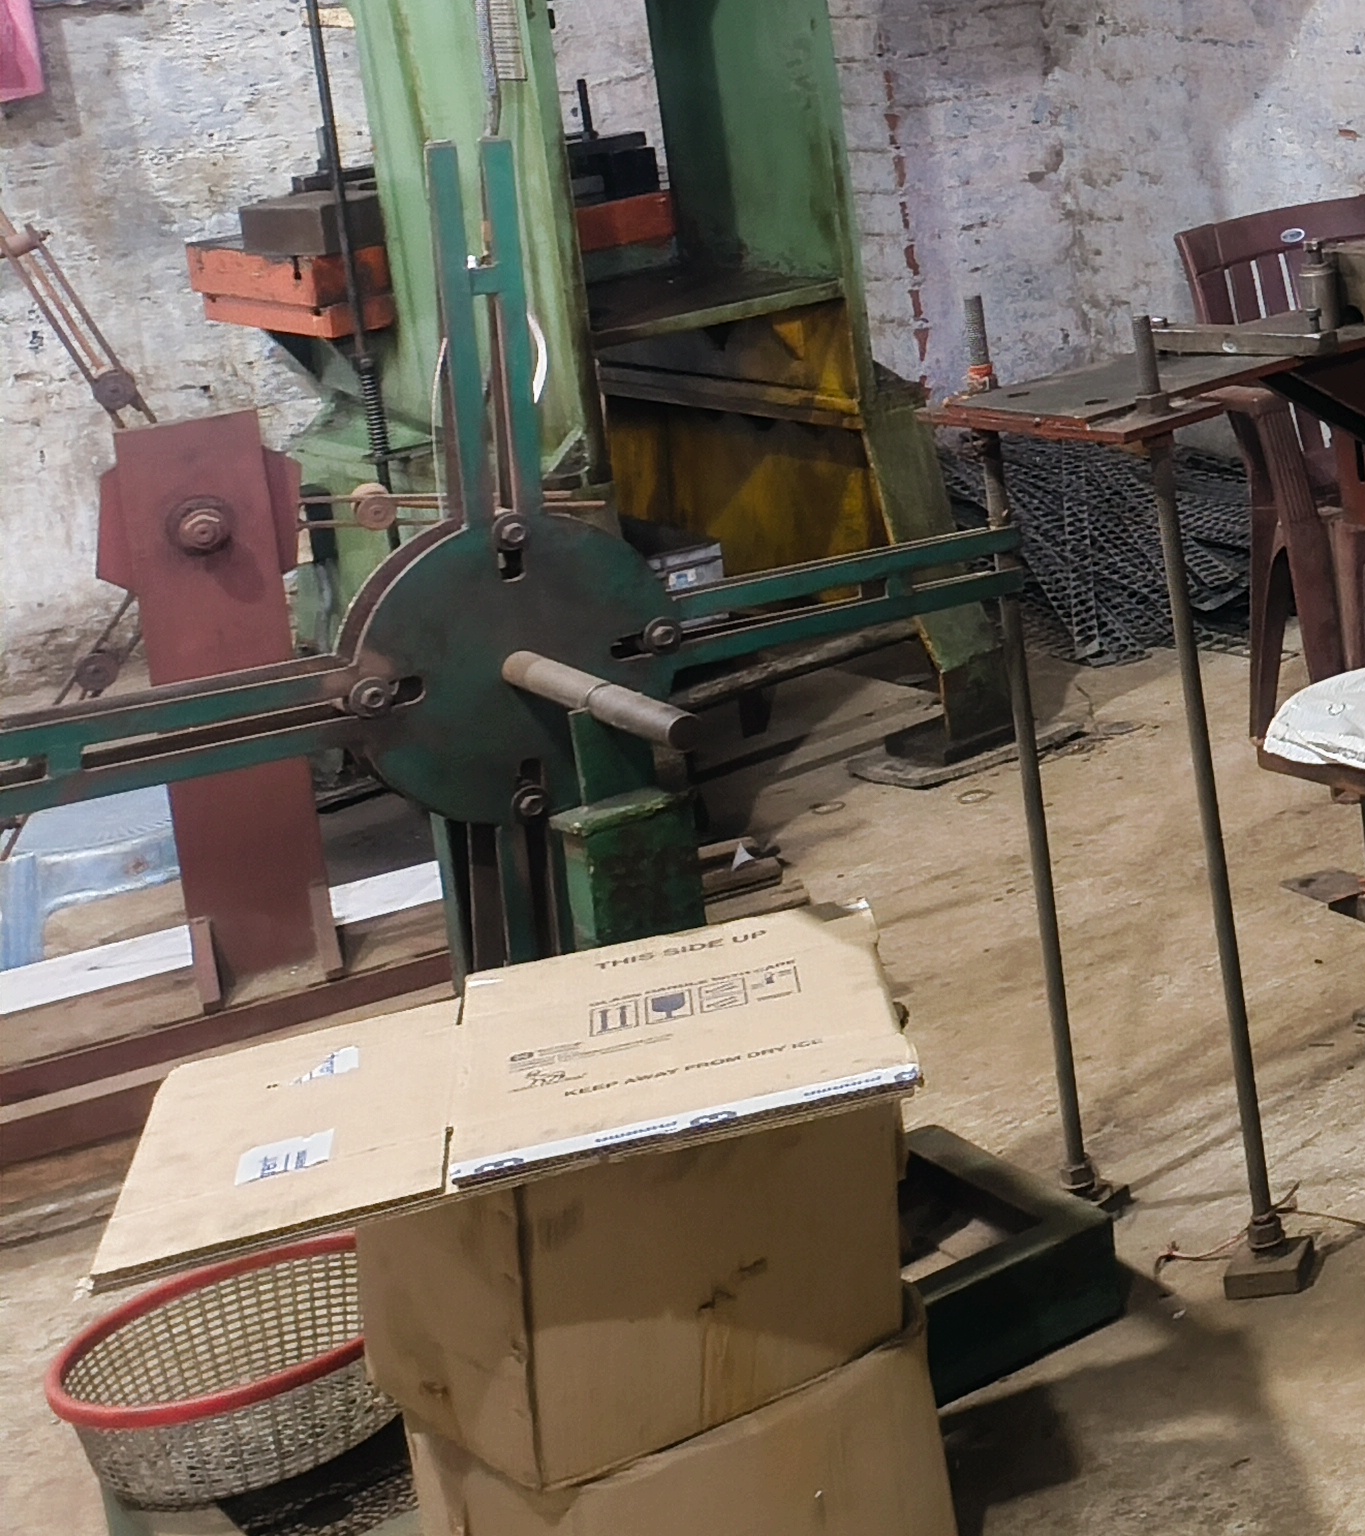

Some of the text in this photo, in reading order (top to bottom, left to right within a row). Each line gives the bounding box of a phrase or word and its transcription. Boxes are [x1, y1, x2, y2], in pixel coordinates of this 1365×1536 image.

[595, 929, 768, 970] THIS SIDE UP
[564, 1080, 618, 1097] KEEP
[624, 1068, 679, 1084] AWAY
[684, 1055, 742, 1071] FROM
[747, 1045, 786, 1059] DRY
[792, 1038, 823, 1049] ICE
